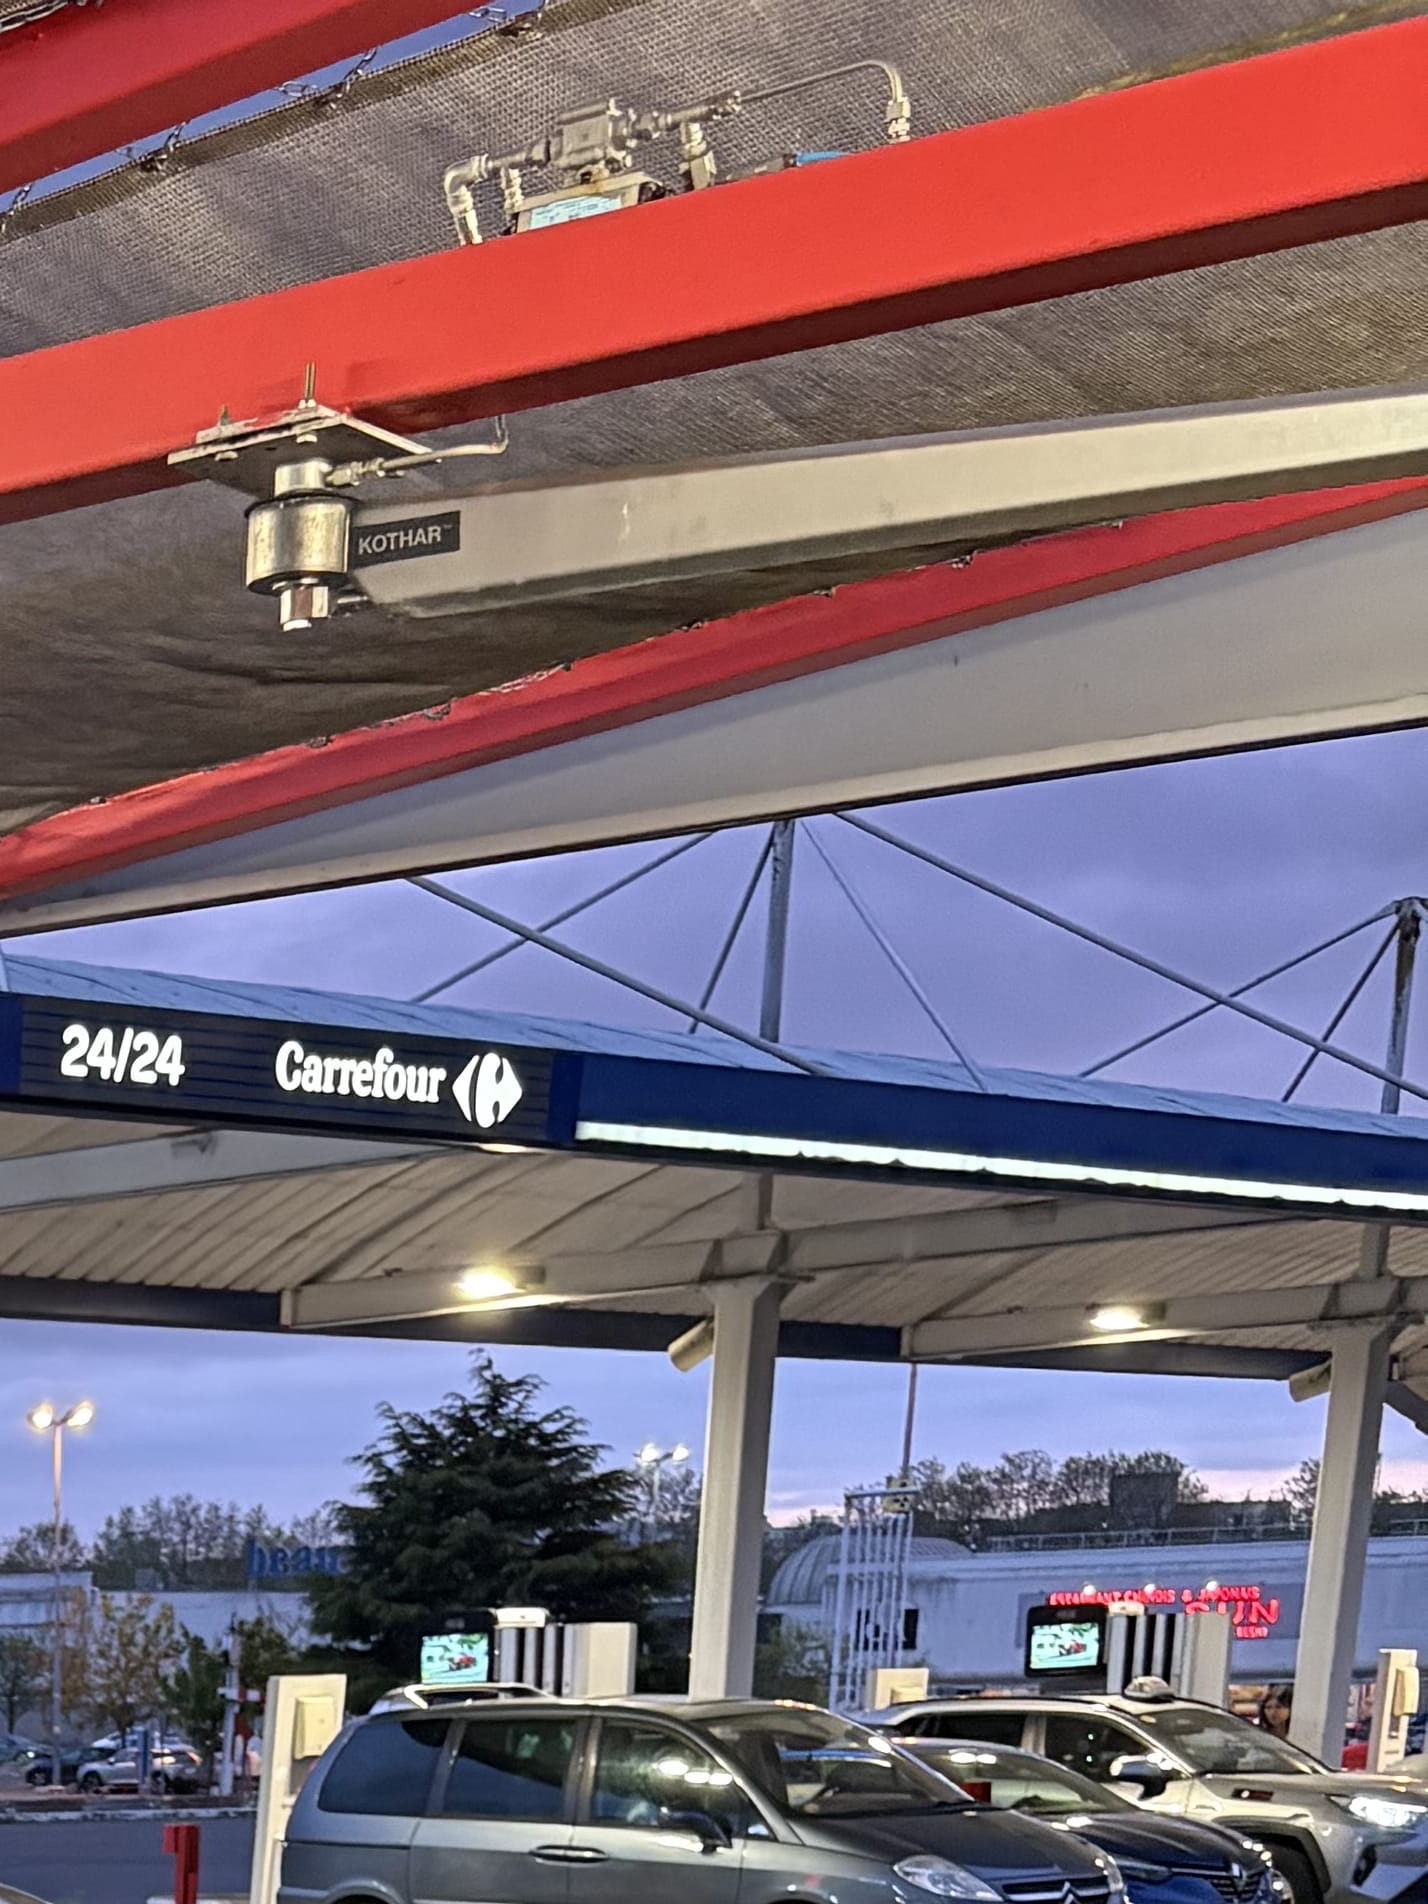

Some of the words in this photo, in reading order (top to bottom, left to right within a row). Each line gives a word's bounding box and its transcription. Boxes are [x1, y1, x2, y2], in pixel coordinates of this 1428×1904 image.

[358, 526, 442, 555] KOTHAR
[60, 1024, 185, 1087] 24/24
[275, 1040, 445, 1103] Carrefour
